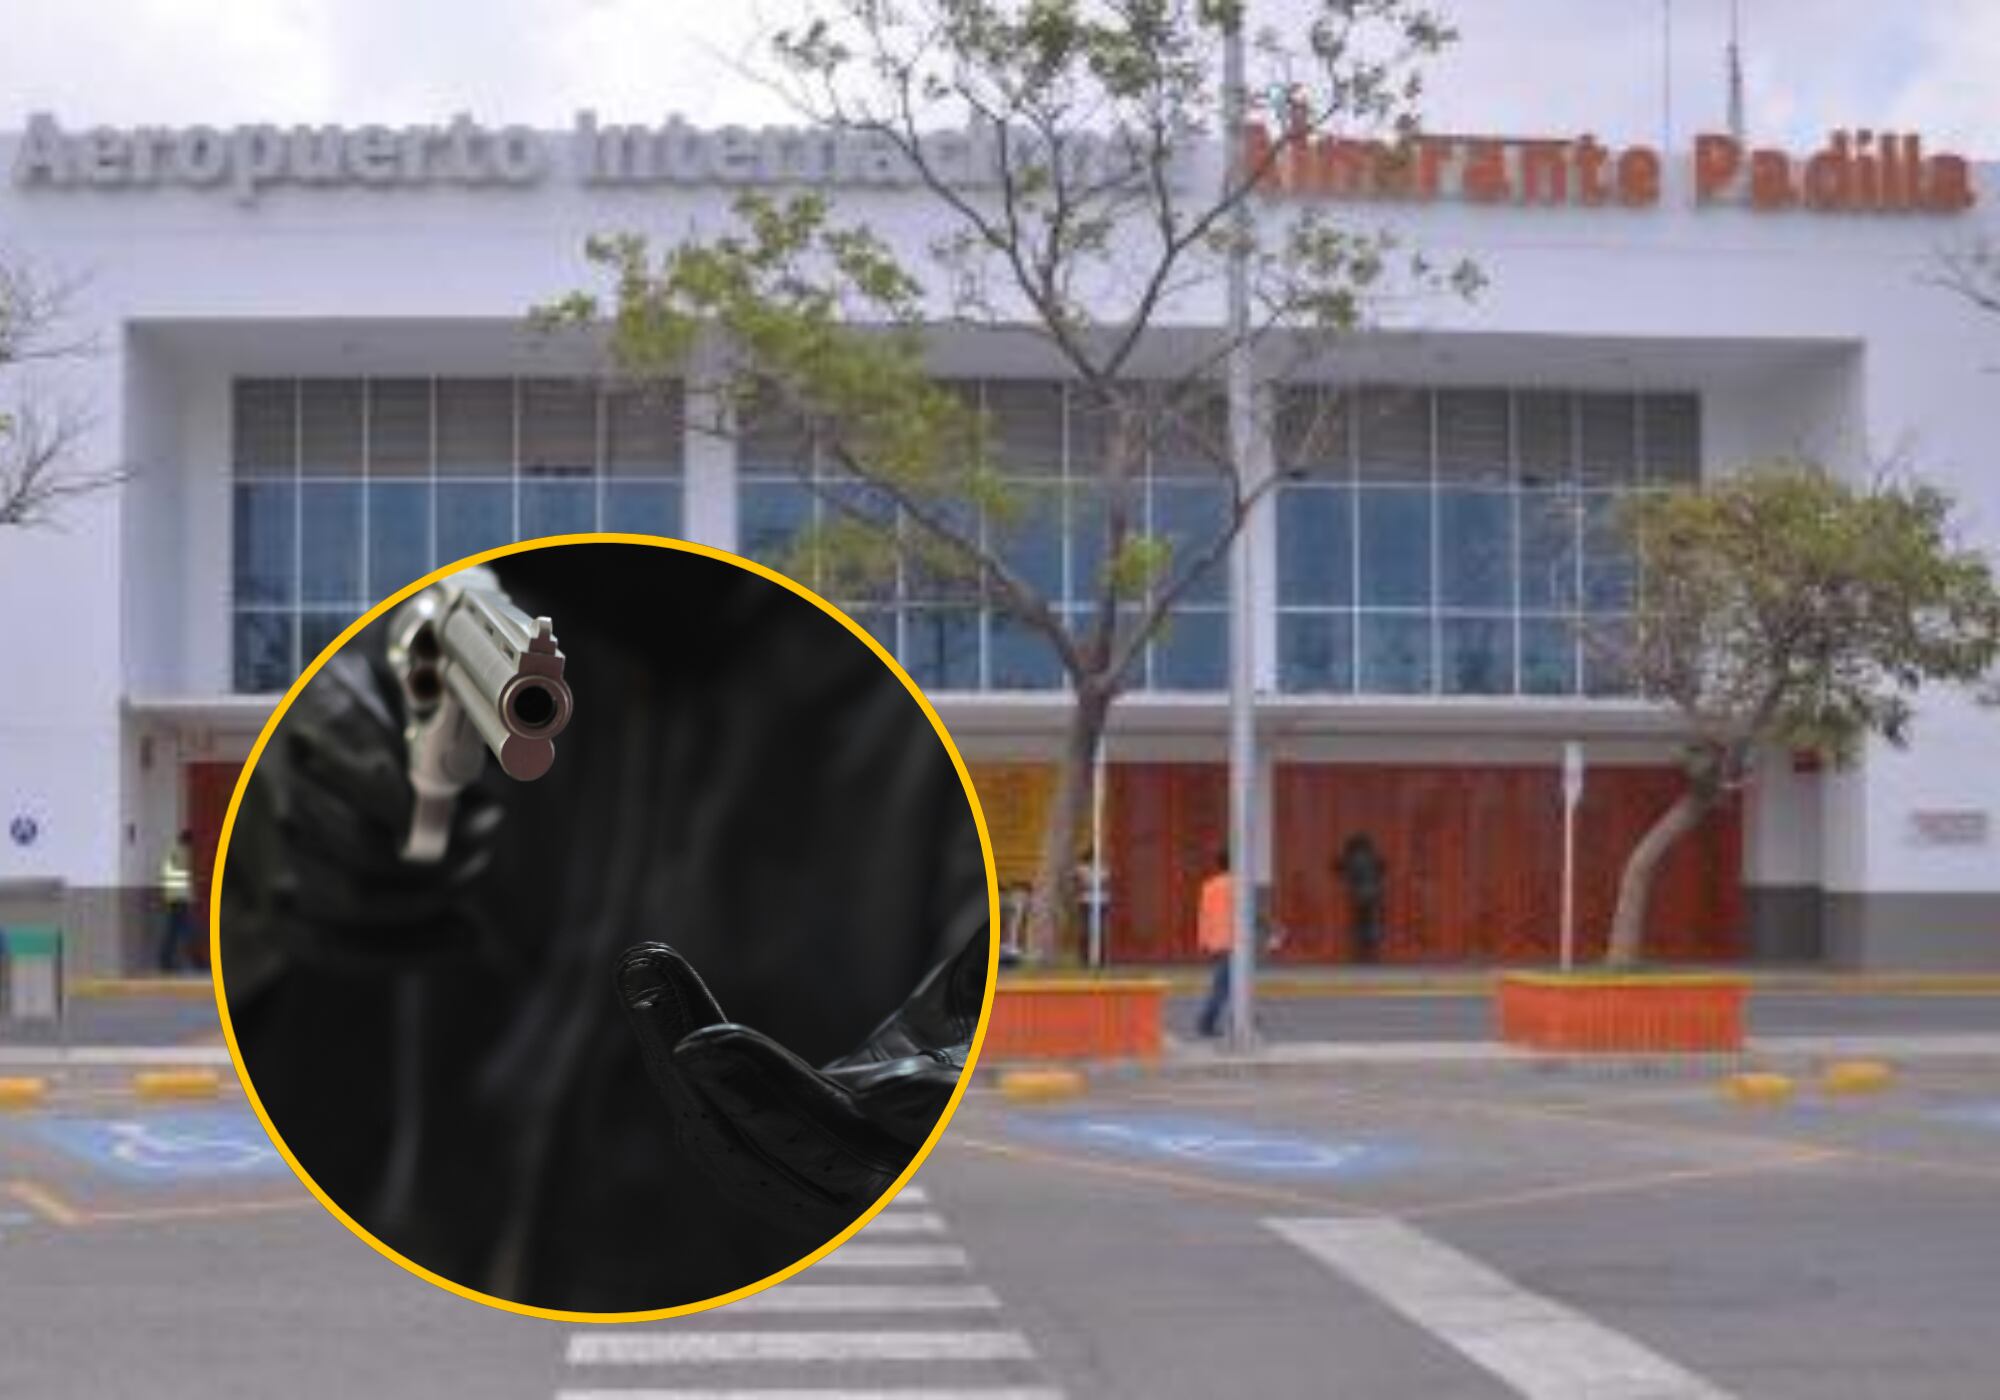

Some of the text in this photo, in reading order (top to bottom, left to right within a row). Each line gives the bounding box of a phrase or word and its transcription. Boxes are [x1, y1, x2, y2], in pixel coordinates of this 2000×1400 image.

[12, 113, 546, 207] Aeropuerto
[575, 111, 1190, 190] Internaci
[1694, 130, 1976, 214] Padilla
